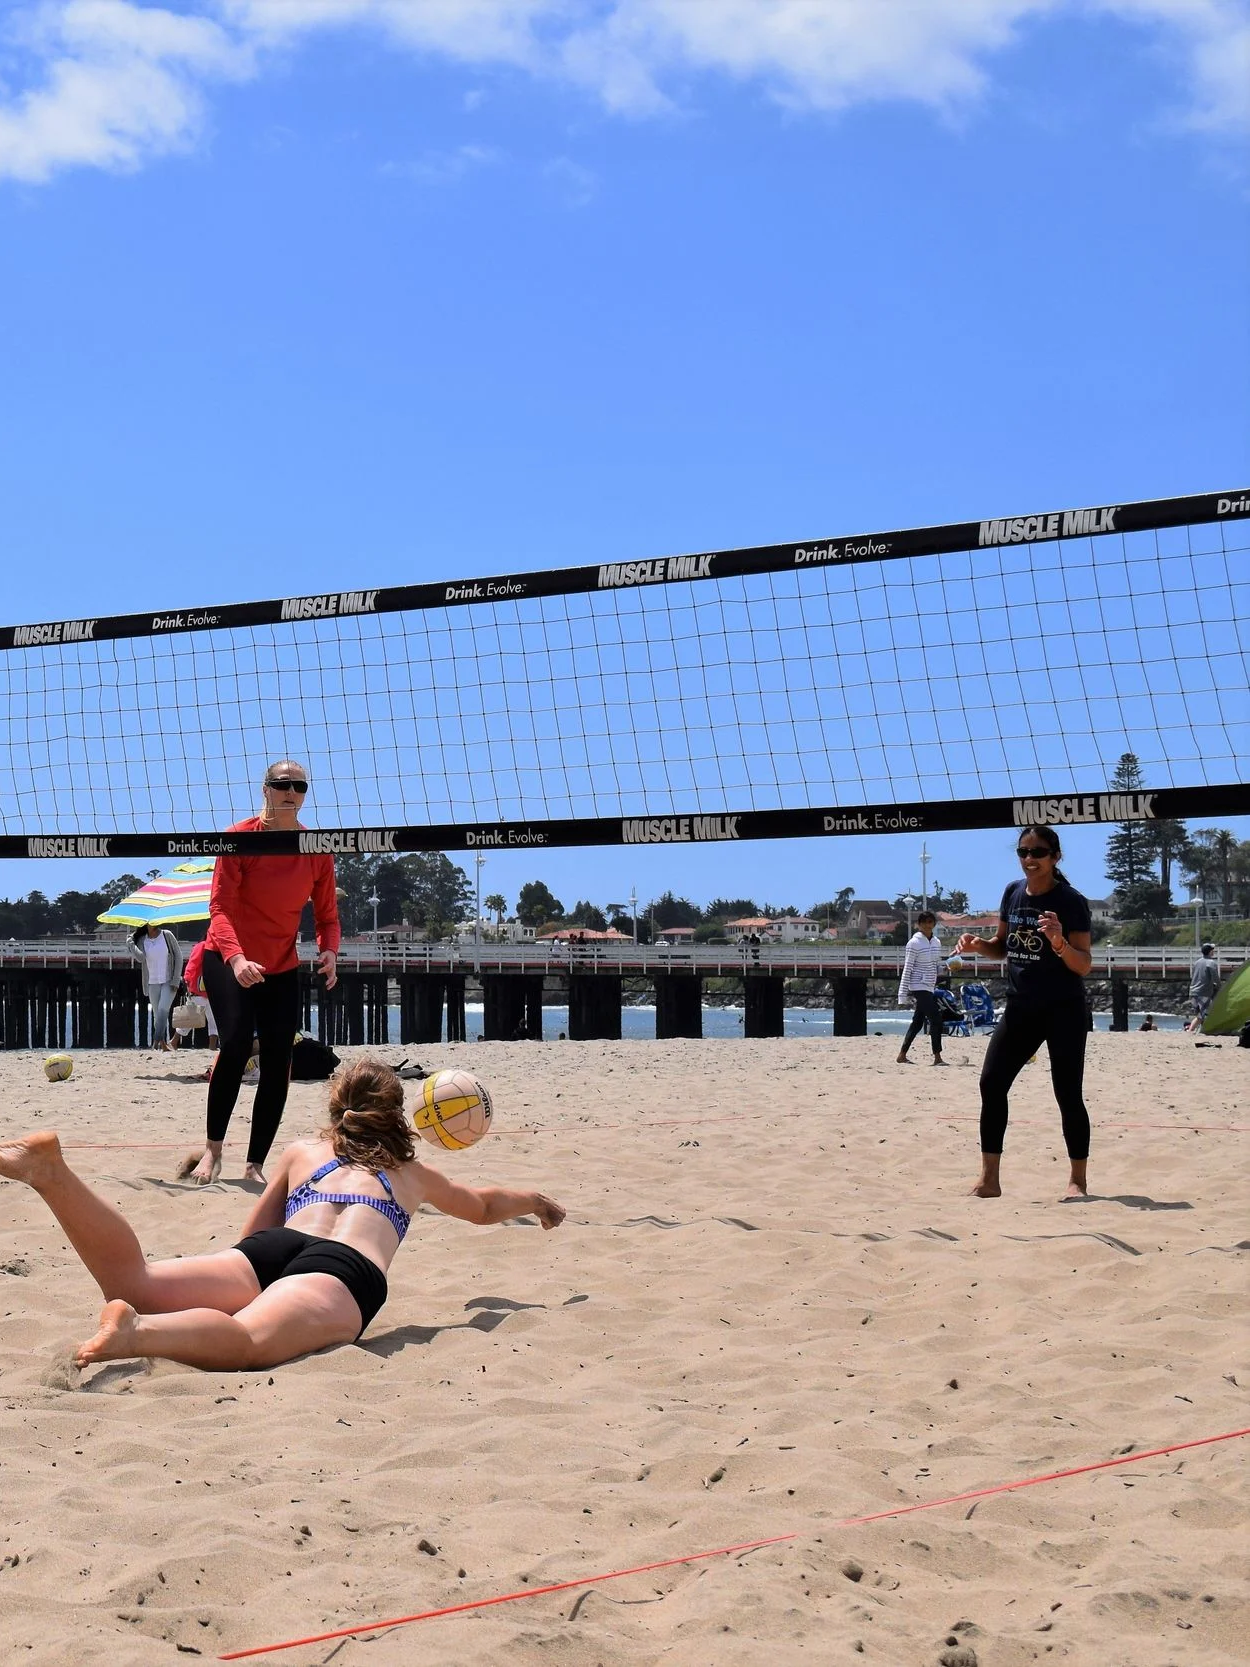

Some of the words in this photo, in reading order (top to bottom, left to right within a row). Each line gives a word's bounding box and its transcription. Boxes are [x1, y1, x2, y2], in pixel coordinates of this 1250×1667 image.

[978, 514, 1060, 546] MUSCLE
[1062, 507, 1116, 536] MILK
[794, 544, 842, 564] Drink.
[597, 563, 665, 588] MUSCLE
[666, 554, 712, 580] MILK
[445, 584, 485, 601] Drink.
[280, 598, 337, 620] MUSCLE
[339, 591, 376, 614] MILK
[13, 624, 61, 646] MUSCLE
[62, 620, 95, 642] MILK
[152, 614, 186, 630] Drink.
[1012, 797, 1097, 826] MUSCLE
[1099, 793, 1156, 821] MILK
[622, 818, 691, 843] MUSCLE
[693, 815, 740, 840] MILK
[823, 813, 873, 831] Drink.
[28, 837, 76, 858] MUSCLE
[77, 836, 110, 857] MILK
[167, 838, 202, 854] Drink.
[298, 831, 357, 853] MUSCLE
[358, 830, 397, 852] MILK
[466, 829, 507, 846] Drink.
